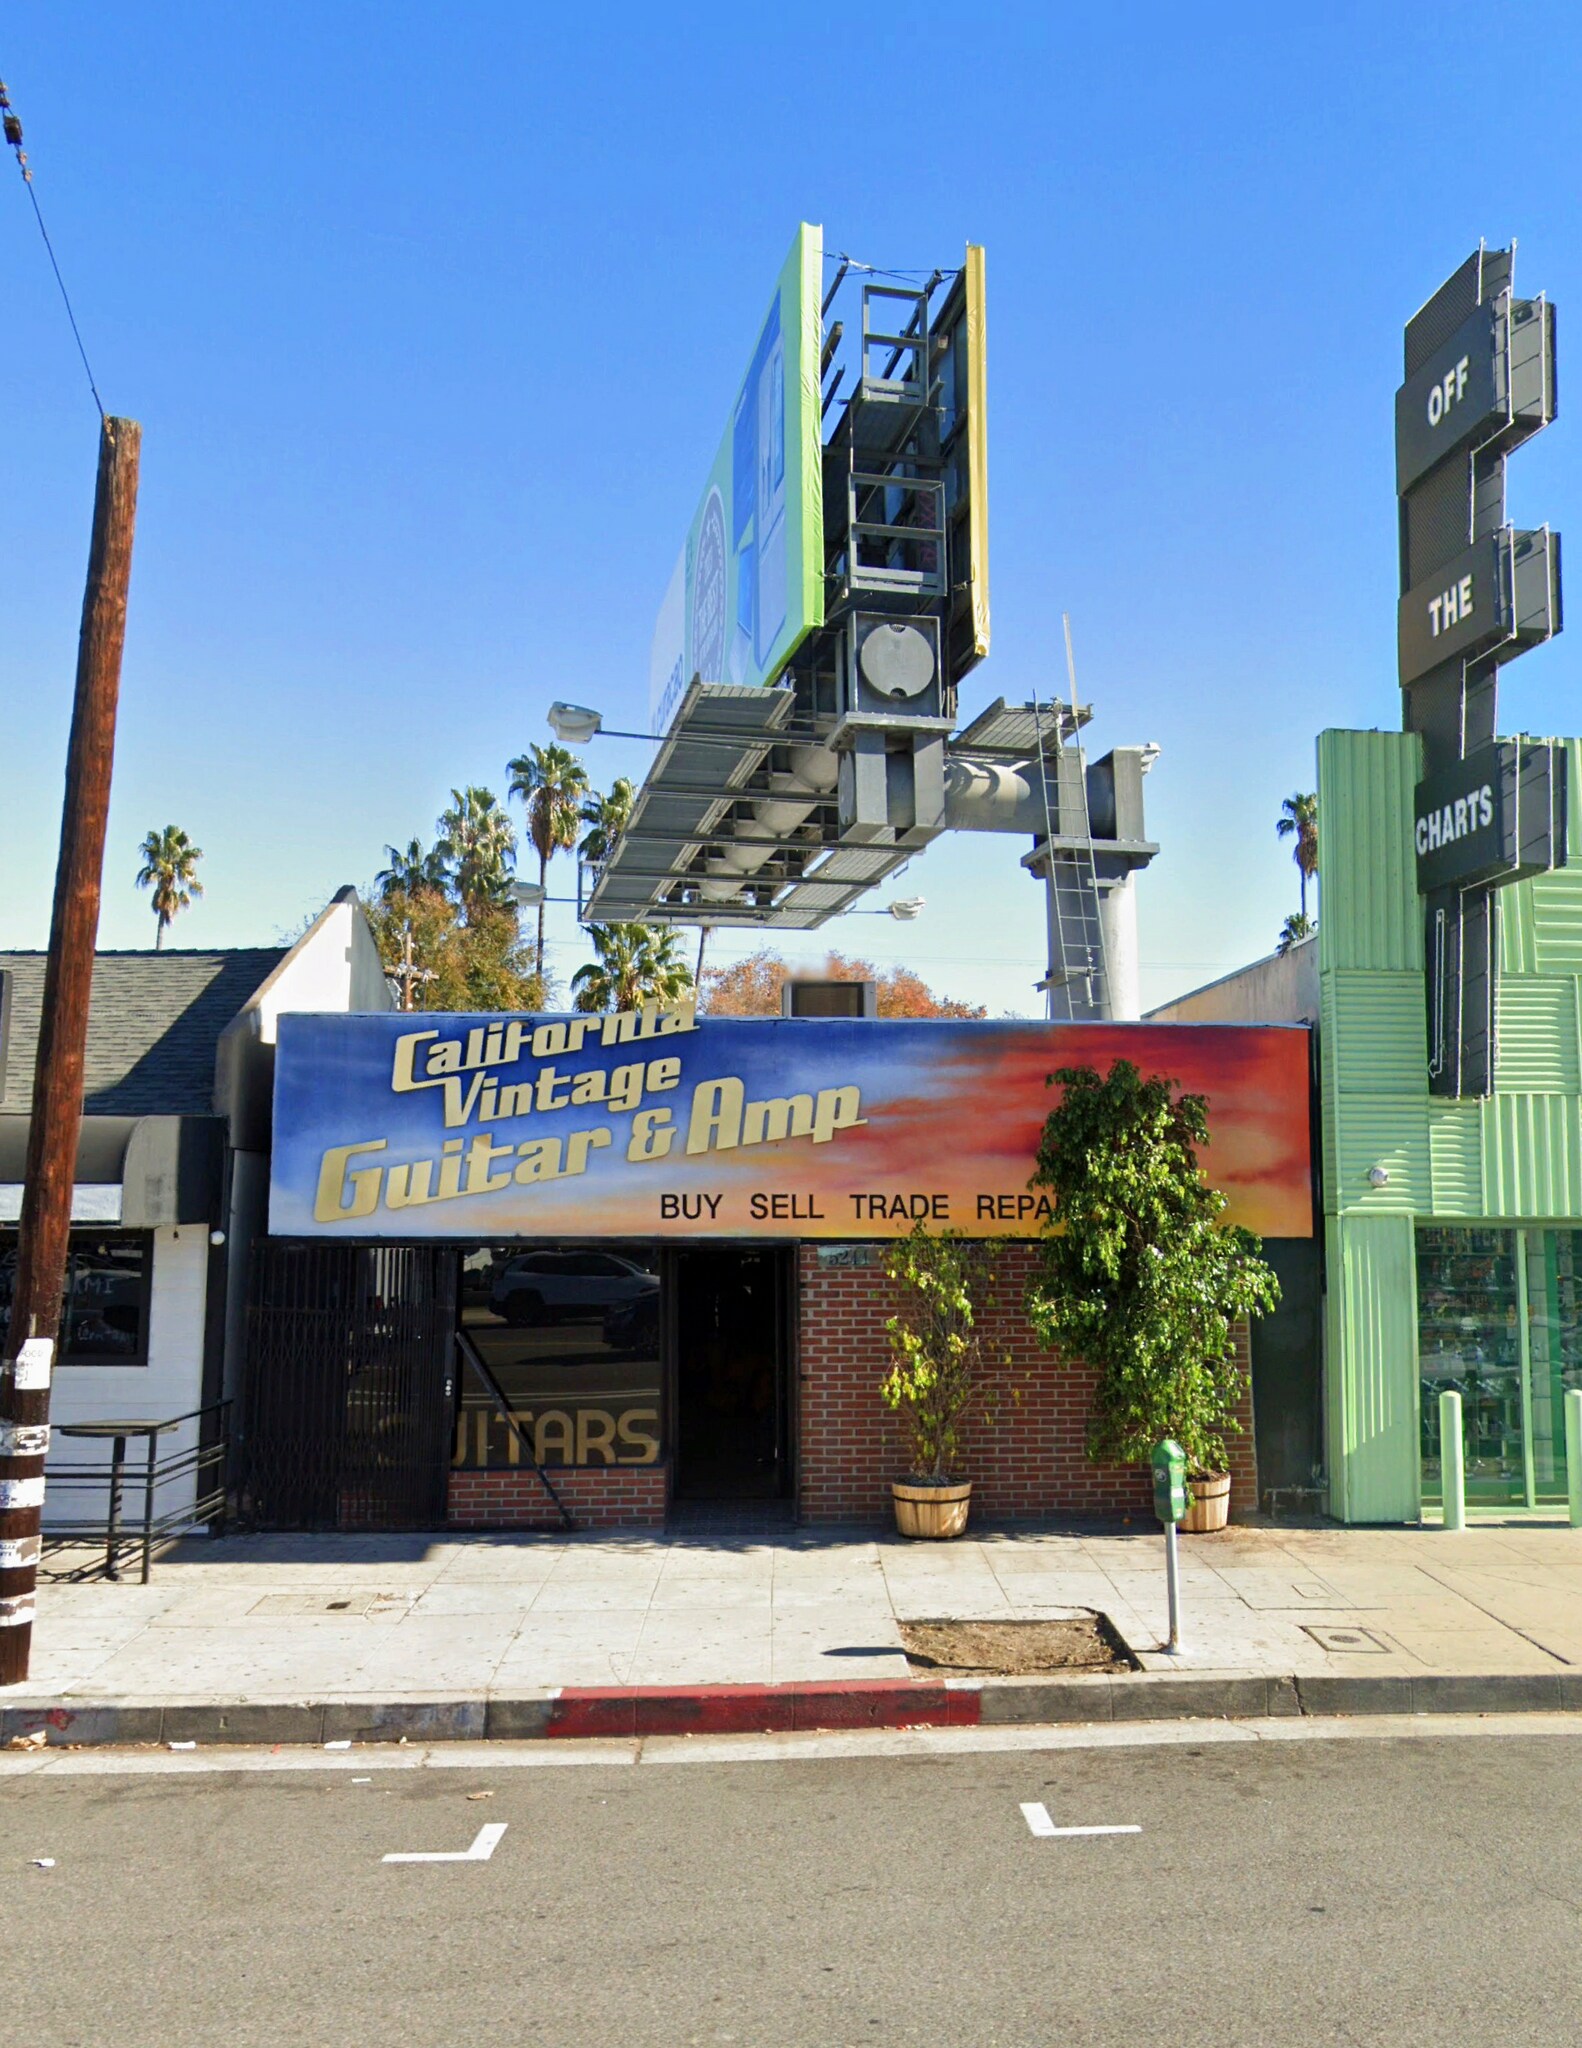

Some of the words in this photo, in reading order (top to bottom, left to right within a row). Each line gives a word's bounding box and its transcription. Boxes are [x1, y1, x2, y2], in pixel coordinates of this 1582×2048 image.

[1428, 355, 1470, 427] OFF
[1428, 574, 1474, 638] THE
[1416, 784, 1493, 856] CHARTS
[391, 1001, 701, 1093] California
[443, 1057, 682, 1128] Vintage
[313, 1127, 612, 1223] Guitar
[626, 1107, 678, 1162] &
[686, 1076, 869, 1156] Amp
[661, 1194, 721, 1220] BUY
[749, 1194, 825, 1220] SELL
[850, 1194, 950, 1220] TRADE
[977, 1194, 1060, 1220] REPA
